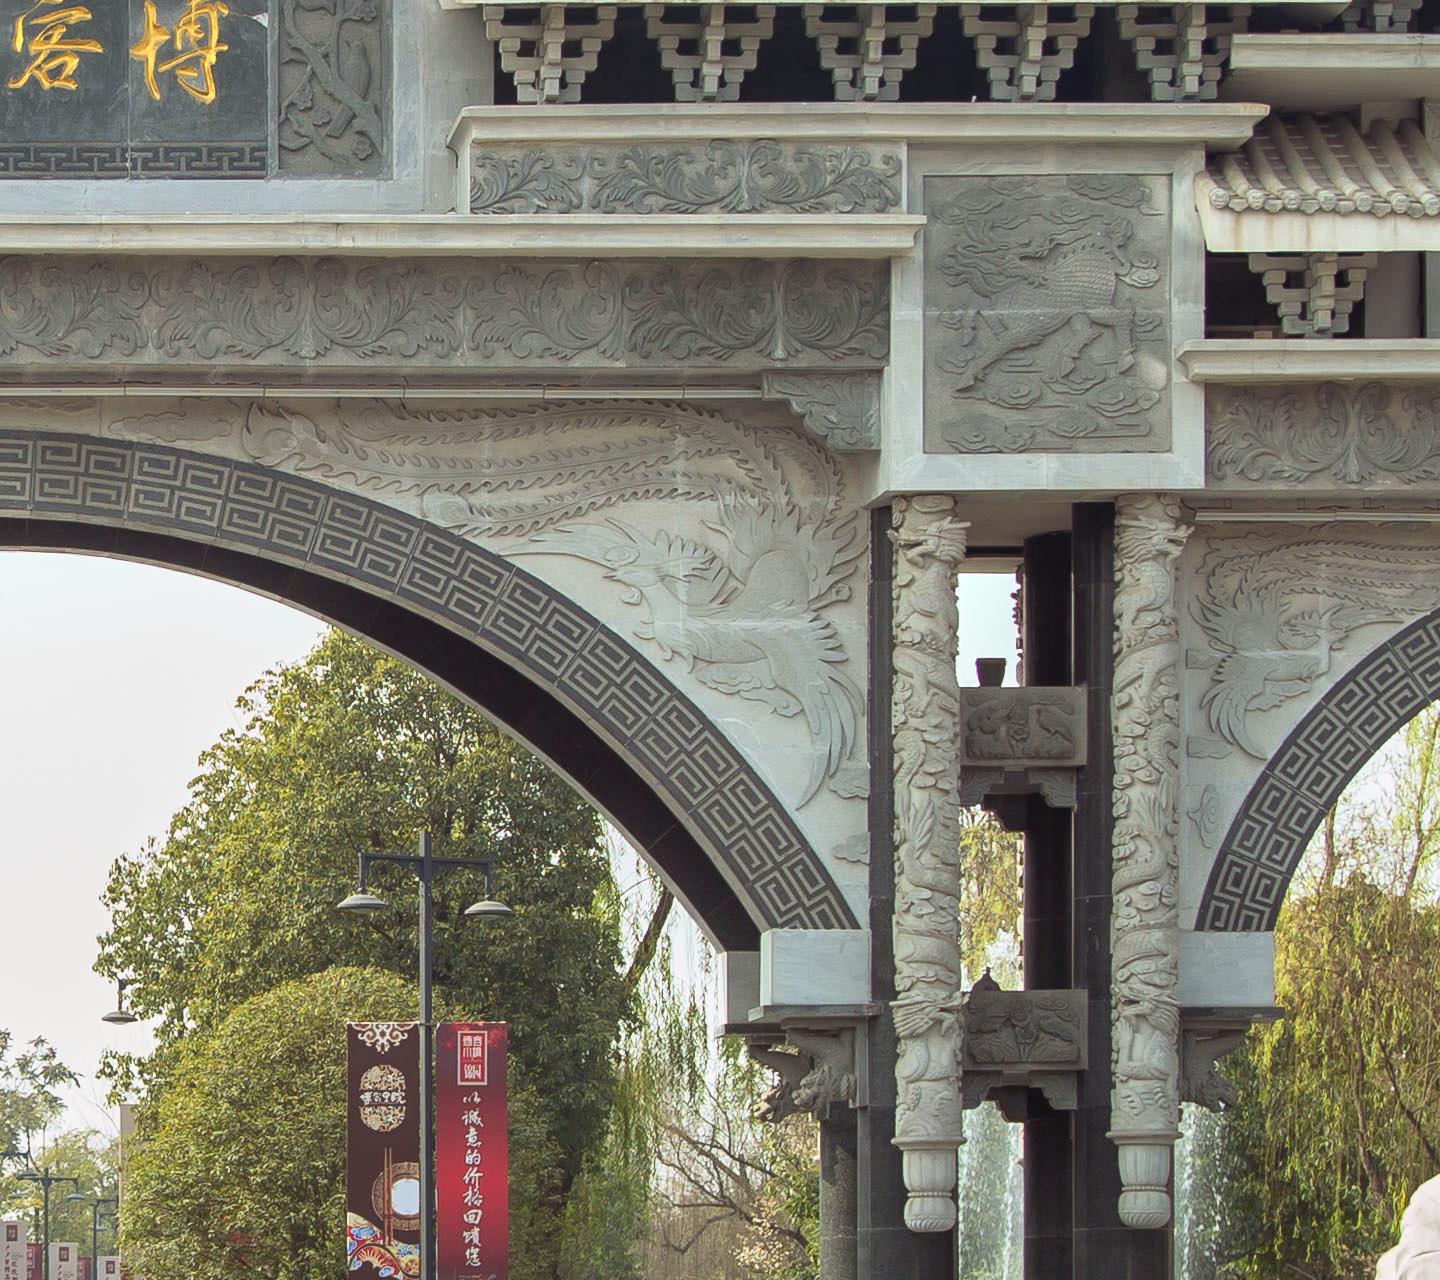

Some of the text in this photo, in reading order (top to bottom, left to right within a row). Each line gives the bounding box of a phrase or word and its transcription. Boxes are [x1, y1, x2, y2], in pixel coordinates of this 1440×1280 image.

[461, 1091, 484, 1267] 以诚意的价格回馈您
